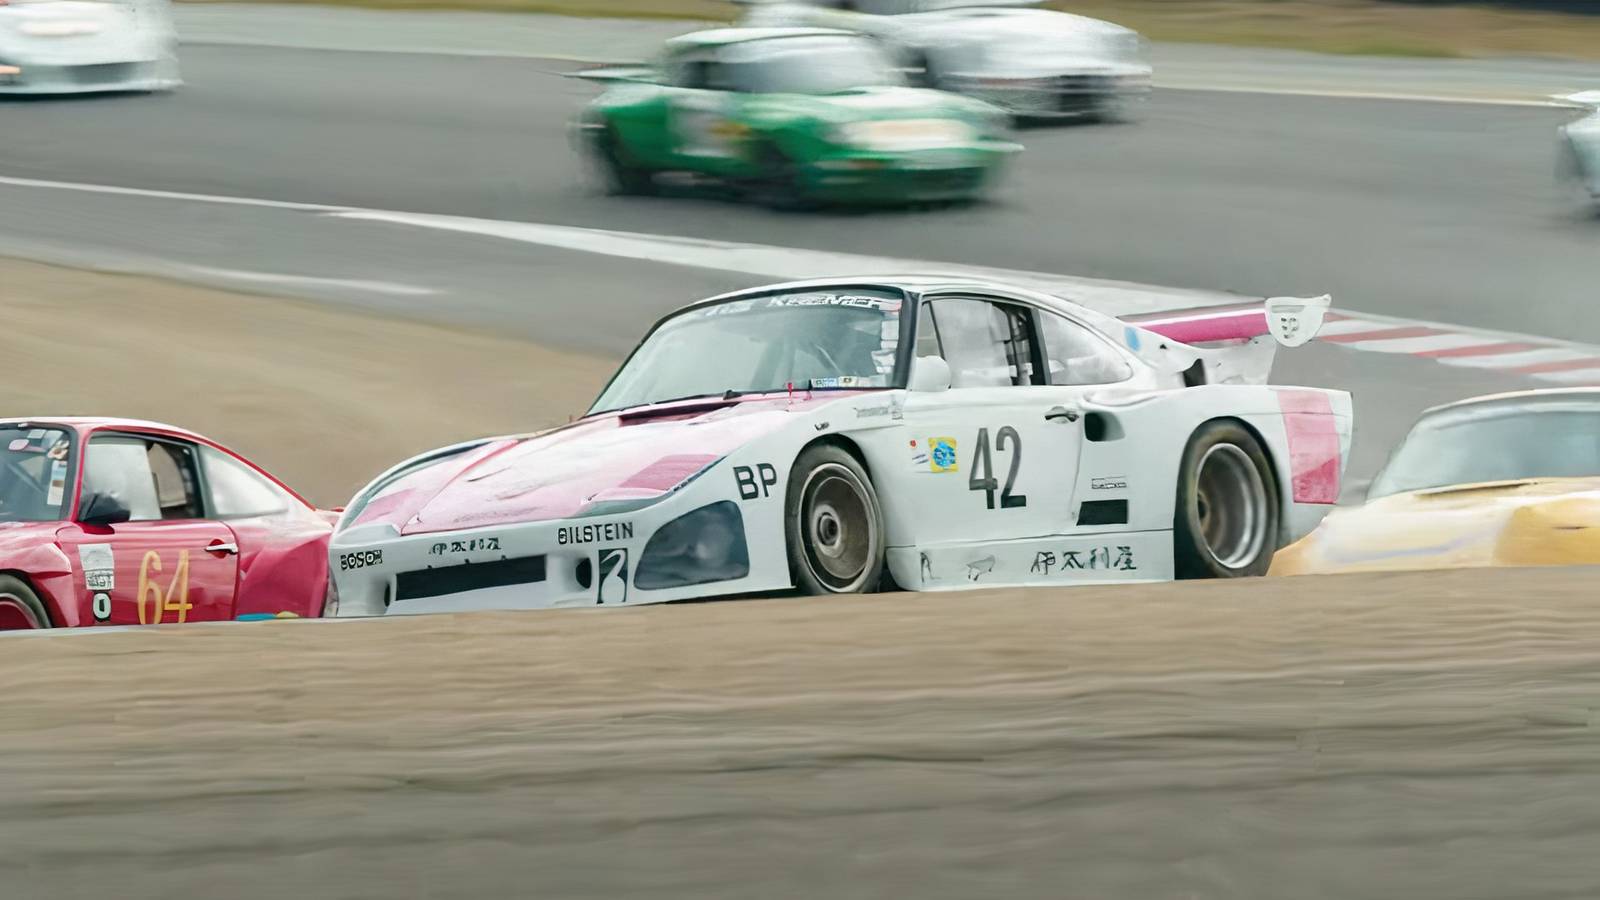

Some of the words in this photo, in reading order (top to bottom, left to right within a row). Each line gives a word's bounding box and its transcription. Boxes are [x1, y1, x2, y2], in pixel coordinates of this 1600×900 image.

[733, 462, 777, 500] BP
[969, 426, 1026, 509] 42
[137, 549, 193, 624] 64
